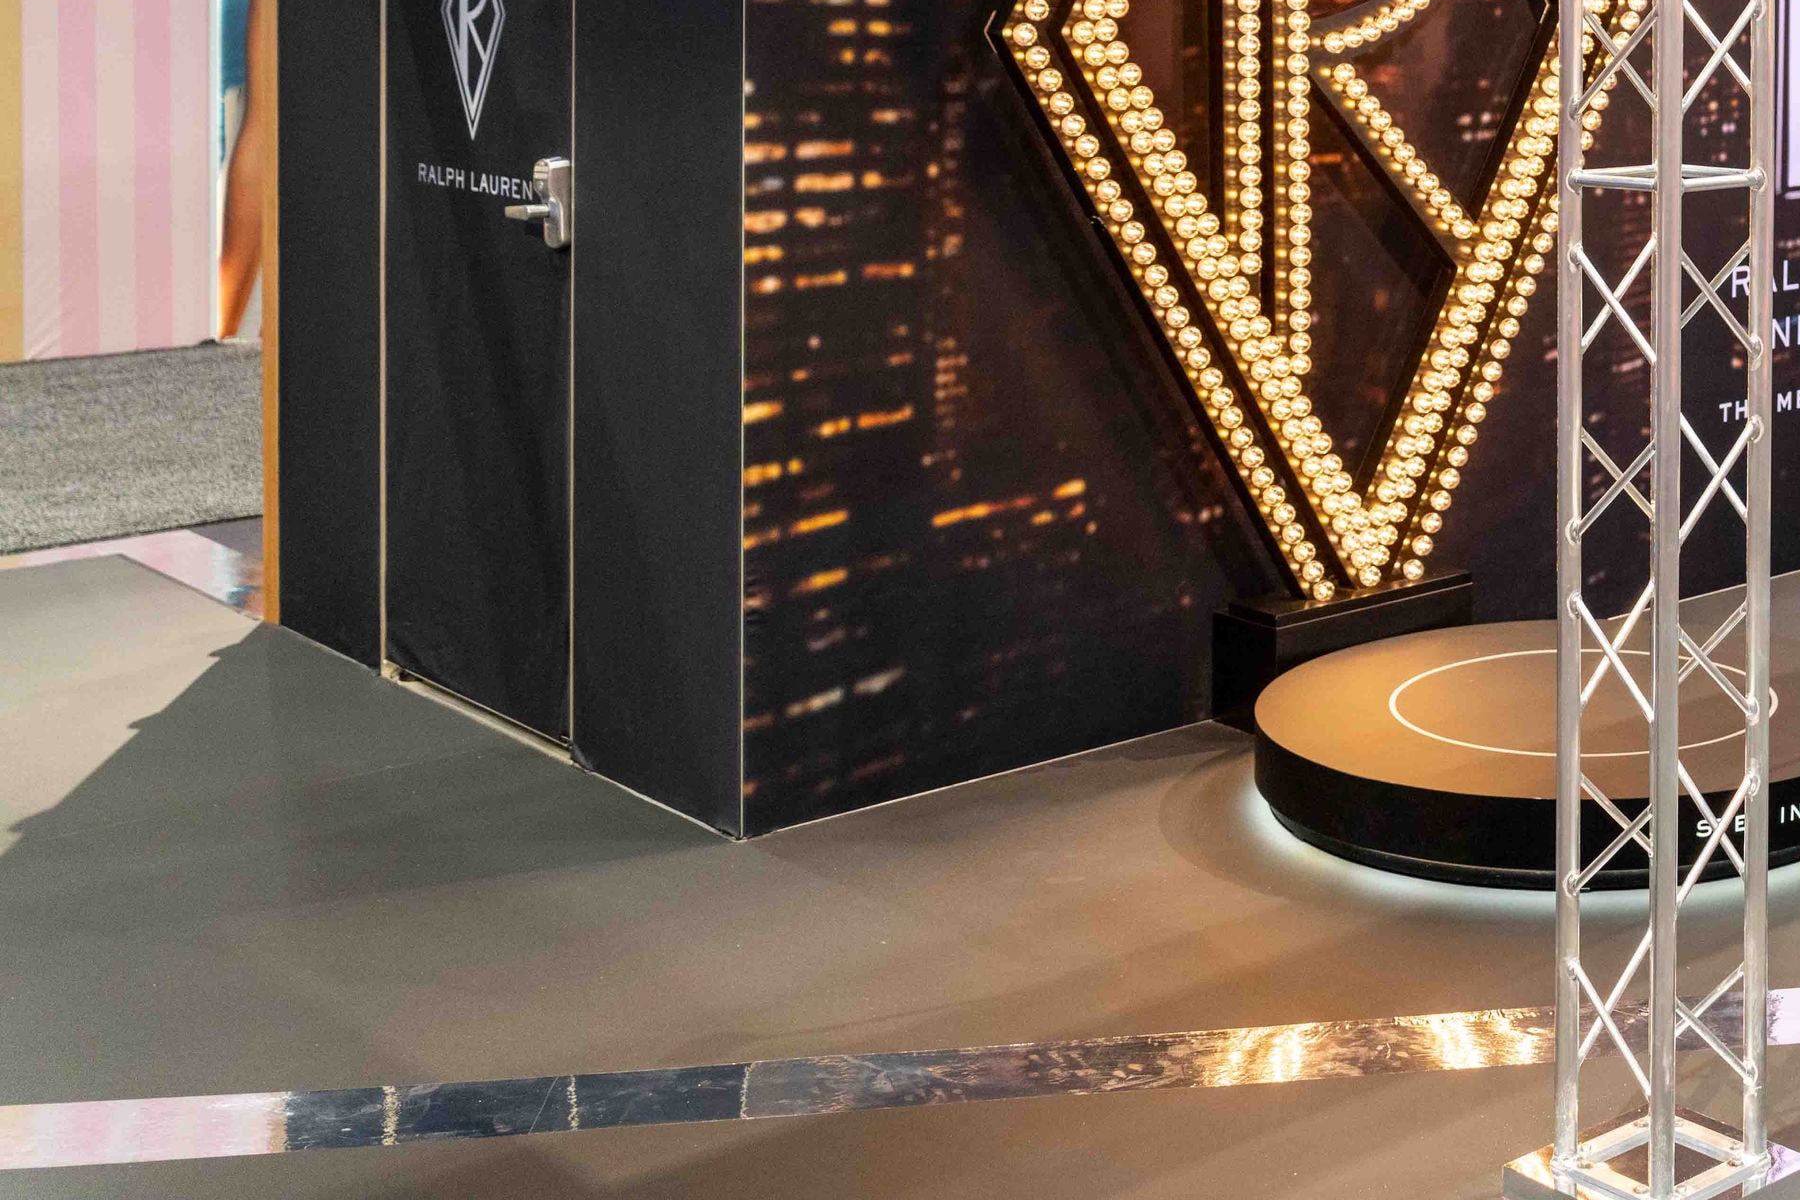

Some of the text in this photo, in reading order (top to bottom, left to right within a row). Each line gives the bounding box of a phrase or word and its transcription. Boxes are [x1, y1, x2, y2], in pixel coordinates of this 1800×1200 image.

[417, 162, 533, 201] RALPH LAUREN
[1719, 399, 1749, 423] TH
[1695, 813, 1746, 838] SE
